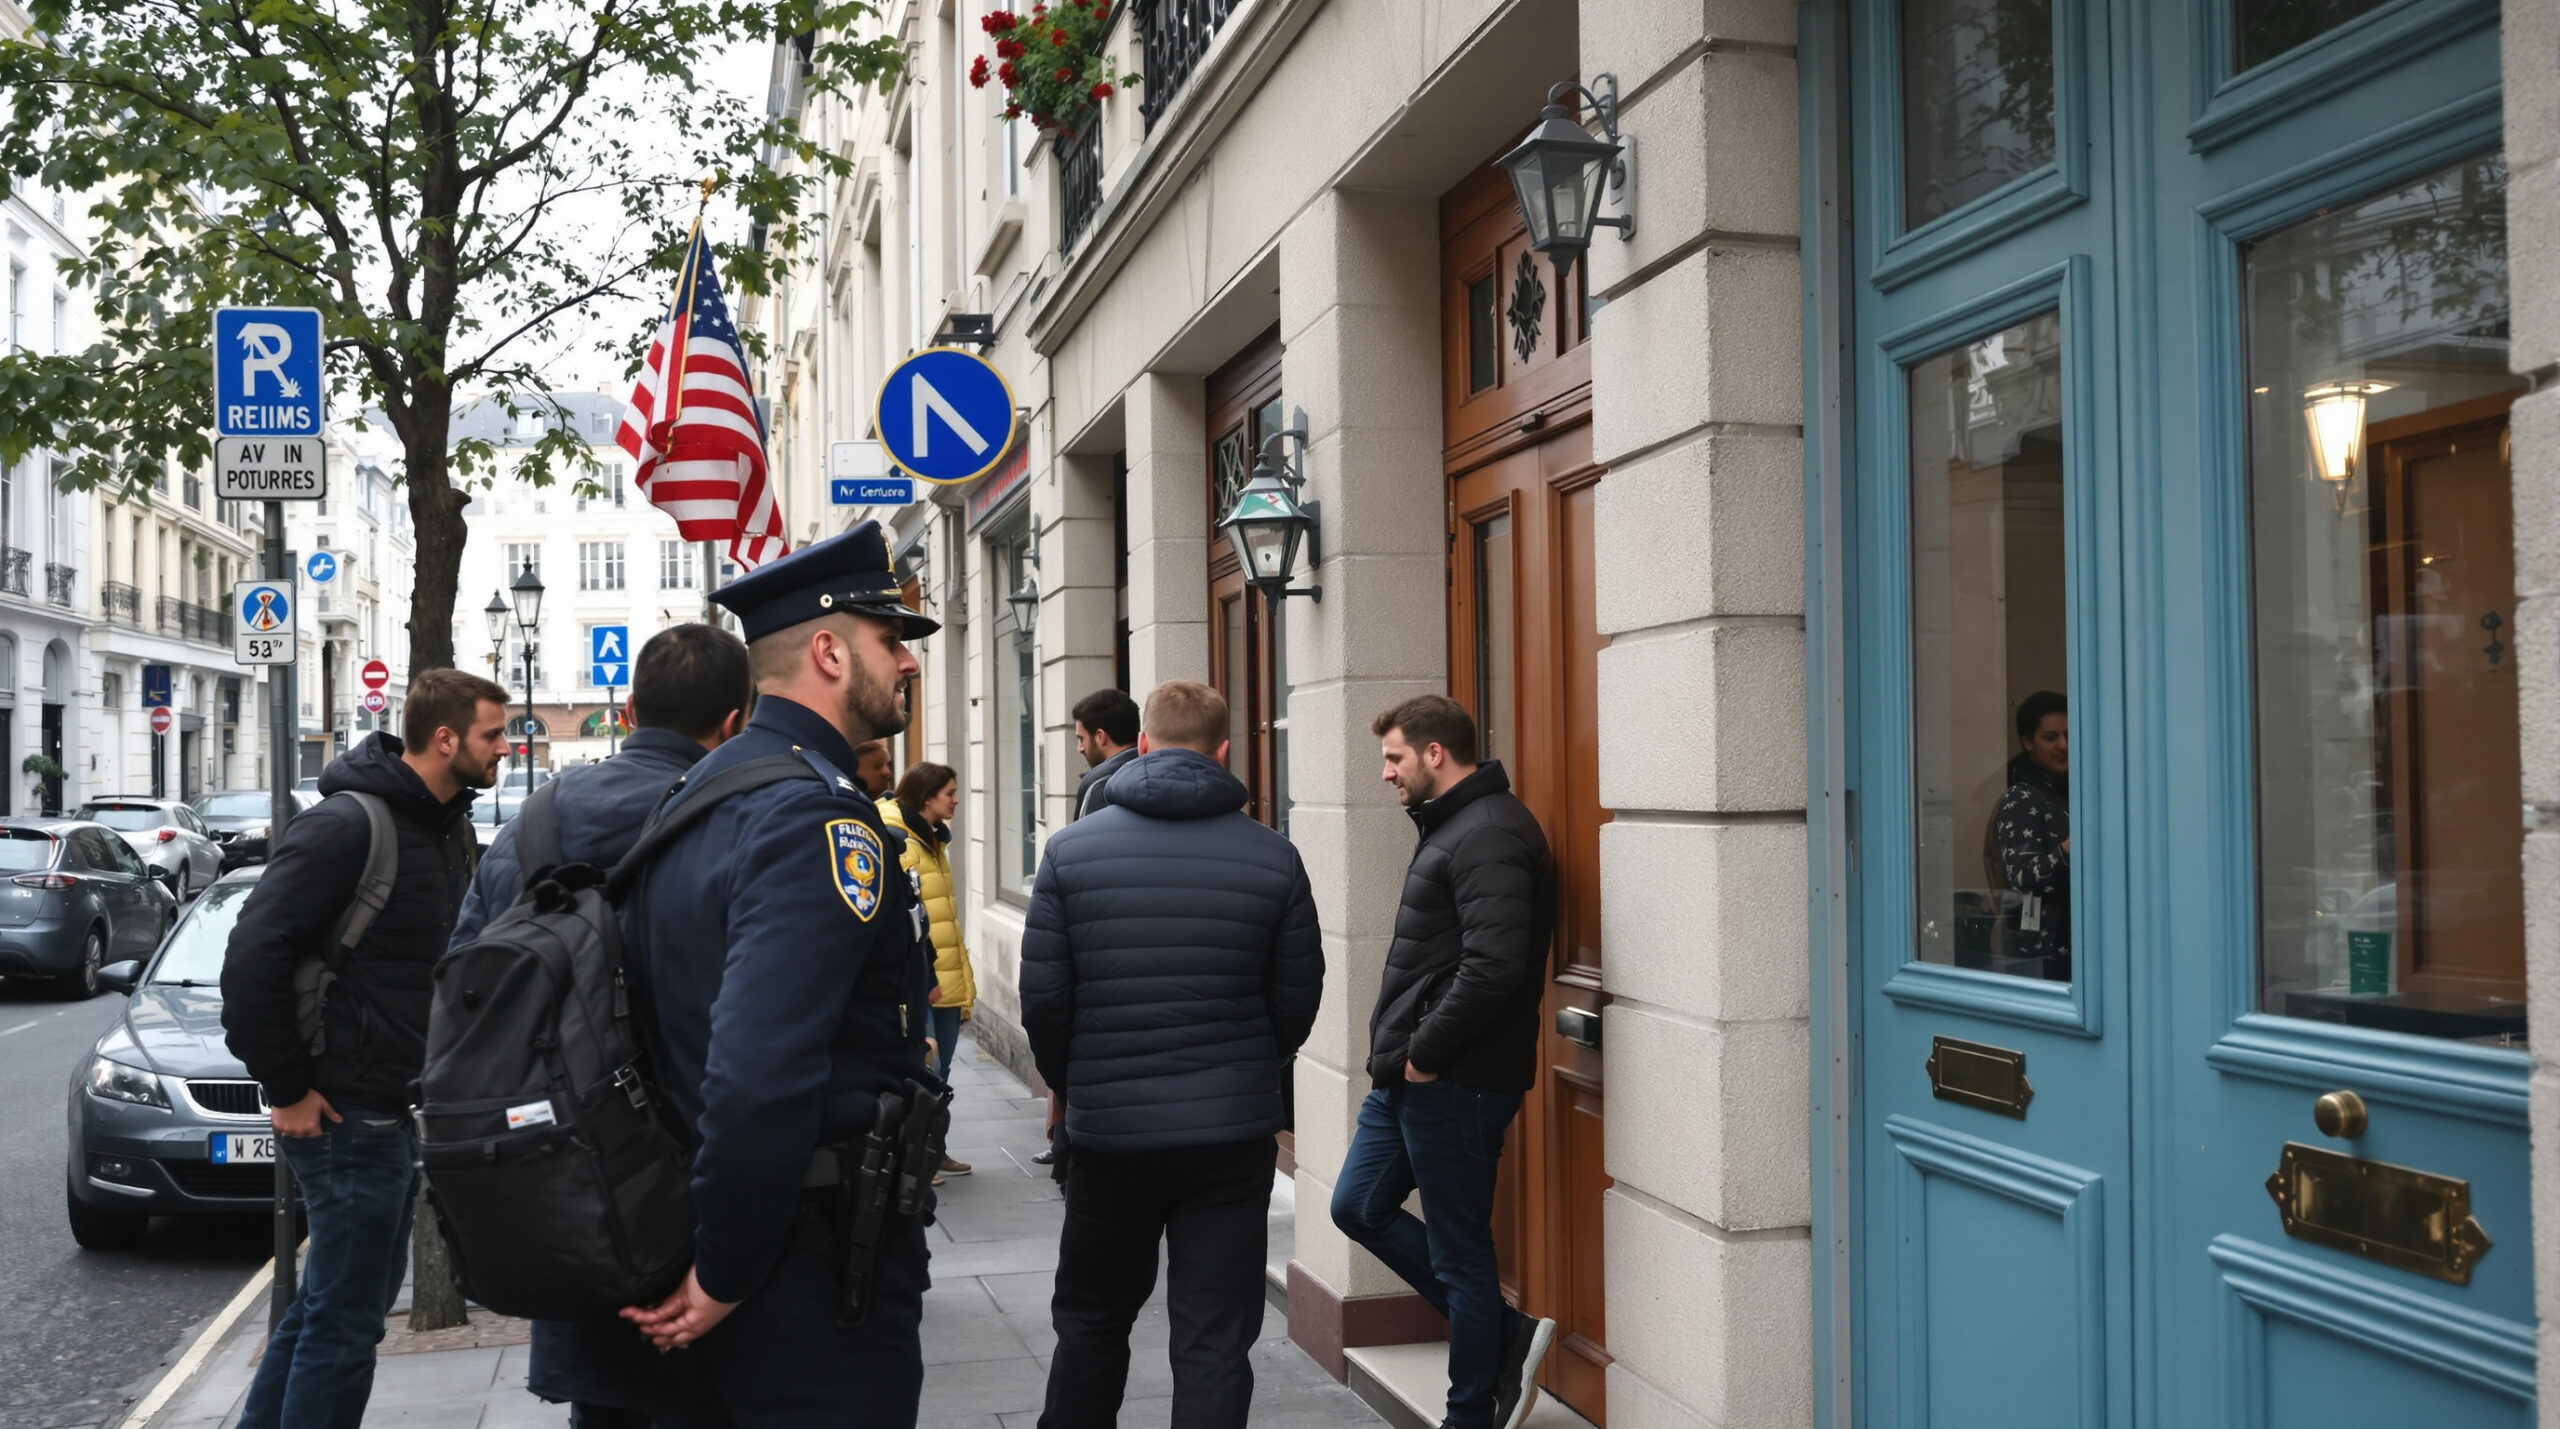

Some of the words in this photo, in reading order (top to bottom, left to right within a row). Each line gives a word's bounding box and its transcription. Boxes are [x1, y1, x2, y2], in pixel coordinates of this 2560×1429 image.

[228, 405, 311, 430] REIIMS
[240, 444, 265, 463] AV
[284, 444, 302, 463] IN
[227, 470, 315, 490] POTURRES
